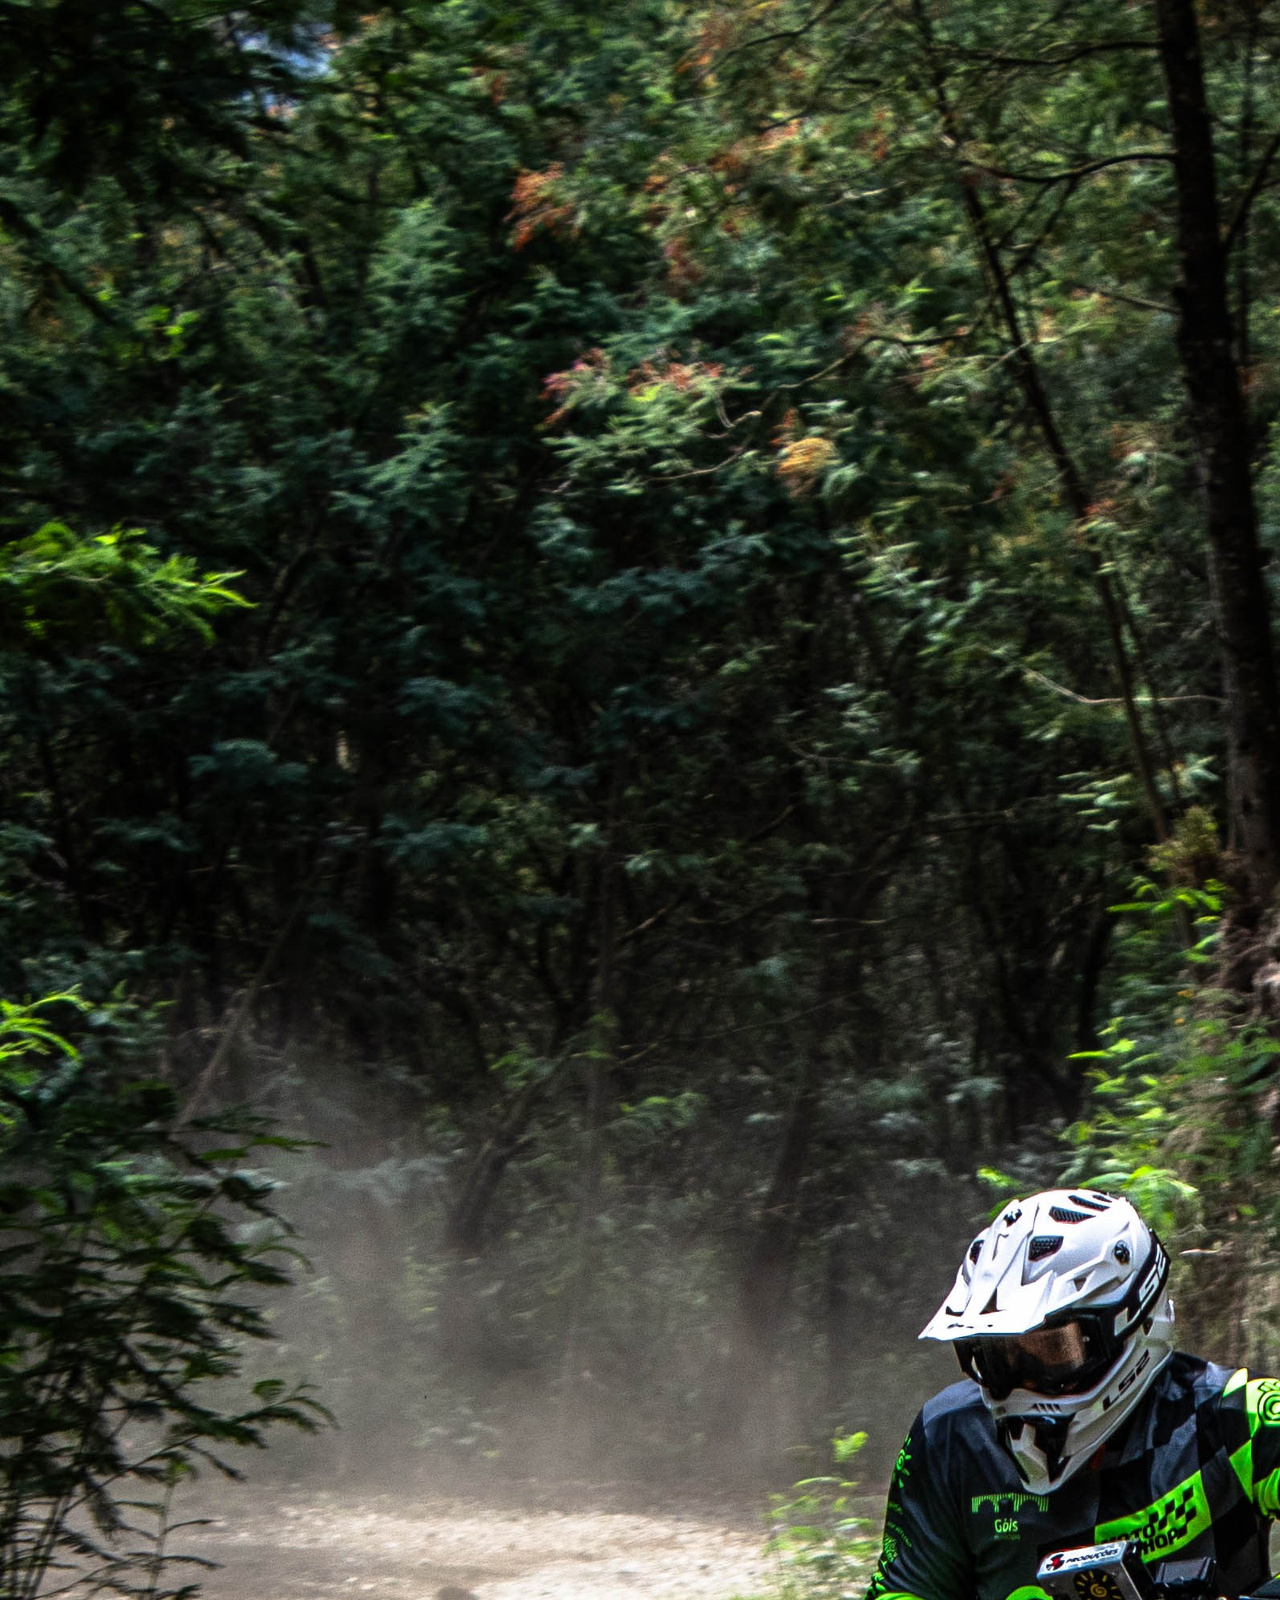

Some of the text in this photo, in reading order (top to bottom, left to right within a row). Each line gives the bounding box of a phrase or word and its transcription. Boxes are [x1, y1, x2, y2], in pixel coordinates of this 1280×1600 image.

[1114, 1243, 1167, 1337] LS2
[1103, 1349, 1150, 1411] LS2
[1141, 1528, 1178, 1556] HOP
